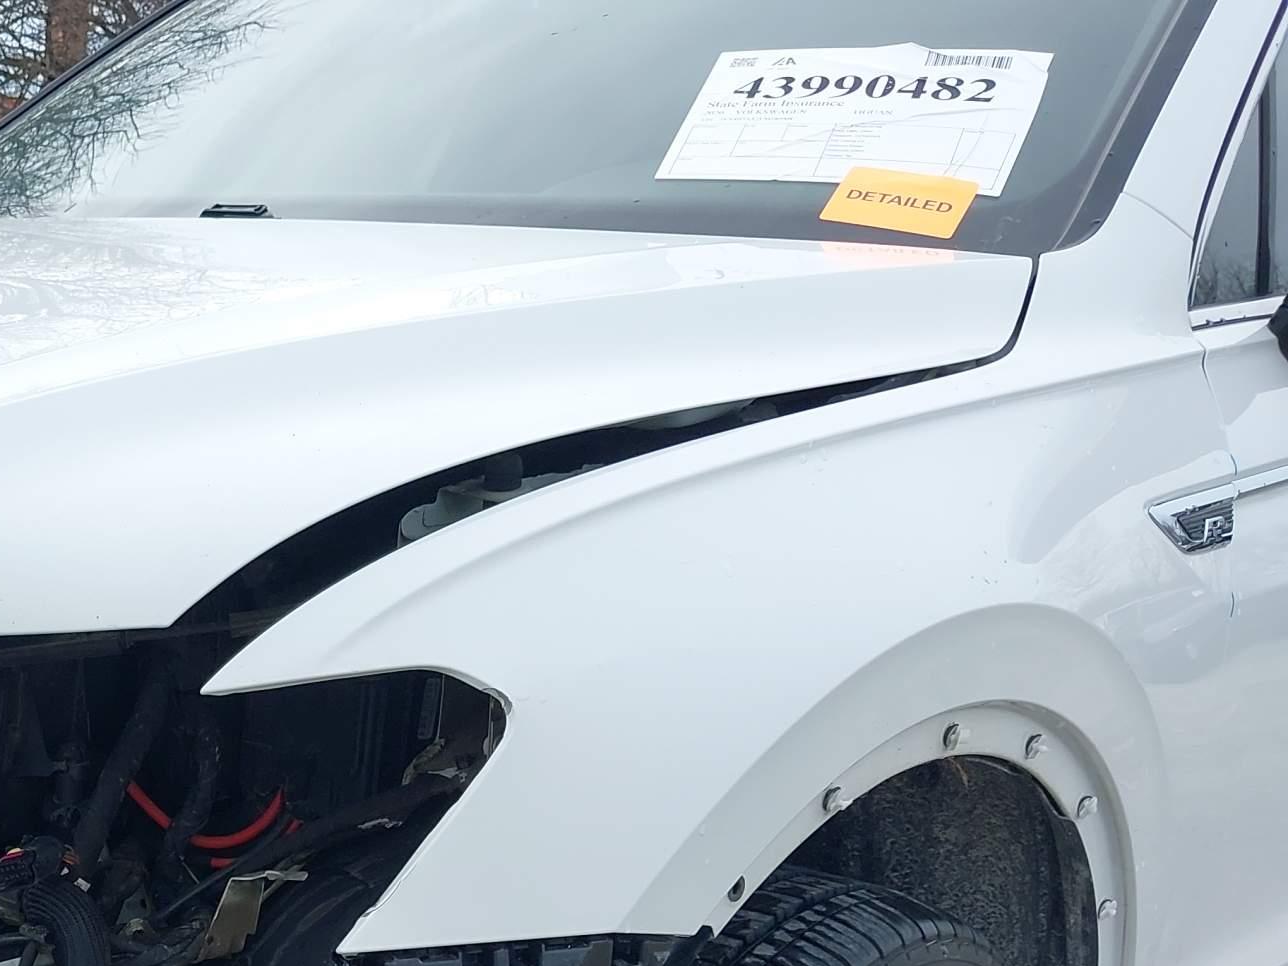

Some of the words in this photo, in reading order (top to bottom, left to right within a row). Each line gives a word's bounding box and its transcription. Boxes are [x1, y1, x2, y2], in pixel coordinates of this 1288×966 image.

[733, 74, 997, 103] 43990482
[706, 100, 740, 109] State
[743, 100, 776, 108] Farm
[781, 99, 845, 108] Insurance
[846, 188, 953, 214] DETAILED
